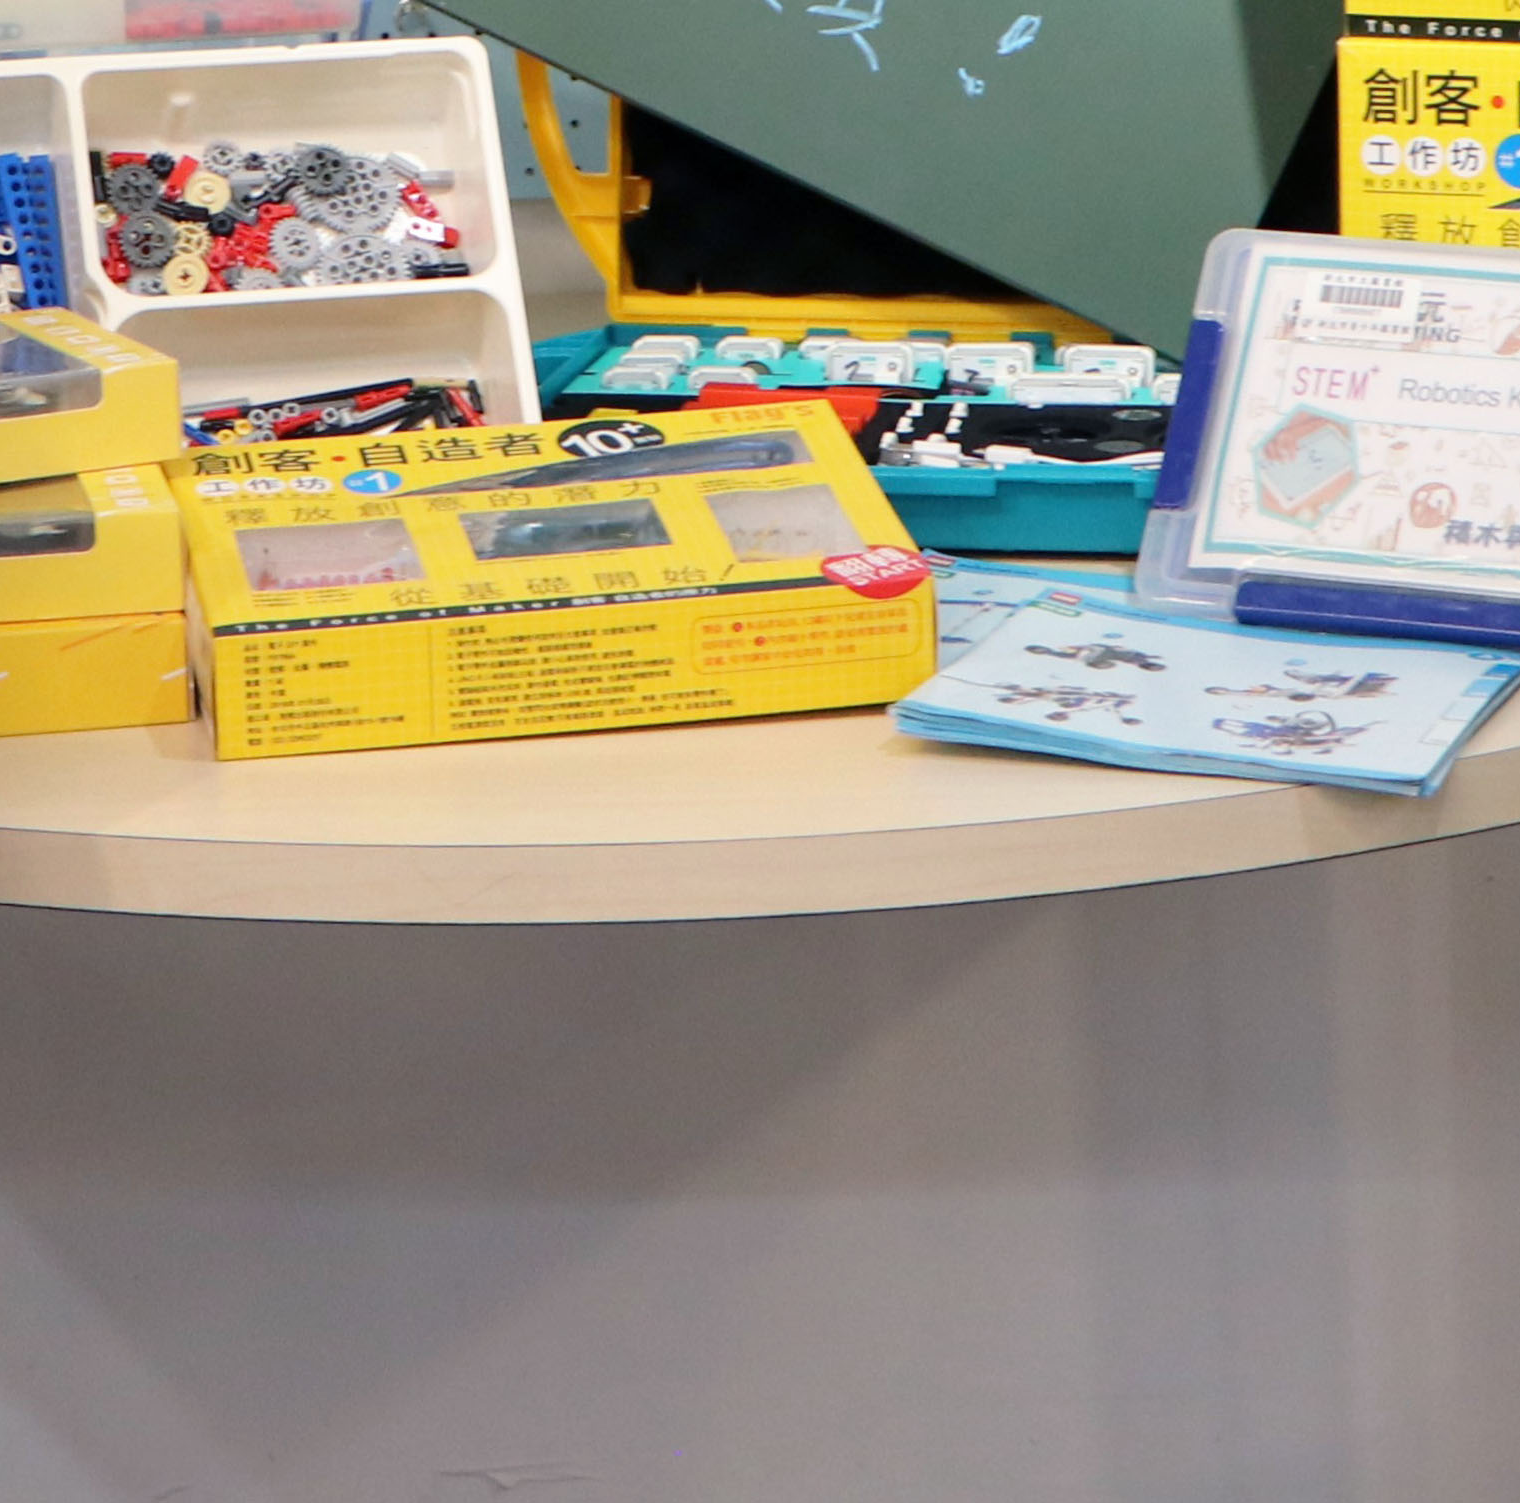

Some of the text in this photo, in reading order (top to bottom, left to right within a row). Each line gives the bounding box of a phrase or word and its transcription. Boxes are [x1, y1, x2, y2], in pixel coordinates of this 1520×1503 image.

[1365, 19, 1412, 35] The
[1427, 21, 1504, 40] Force
[1367, 139, 1483, 174] 工作坊
[1363, 178, 1487, 192] WORKSHOP
[1397, 377, 1502, 408] Robotics
[711, 403, 815, 425] Flag's
[562, 419, 645, 458] 10+
[204, 477, 327, 493] 工作坊
[224, 480, 661, 525] 釋放創意的潛力
[847, 559, 926, 587] START
[235, 622, 289, 634] The
[309, 613, 398, 628] Force
[418, 607, 447, 619] of
[468, 600, 559, 615] Maker
